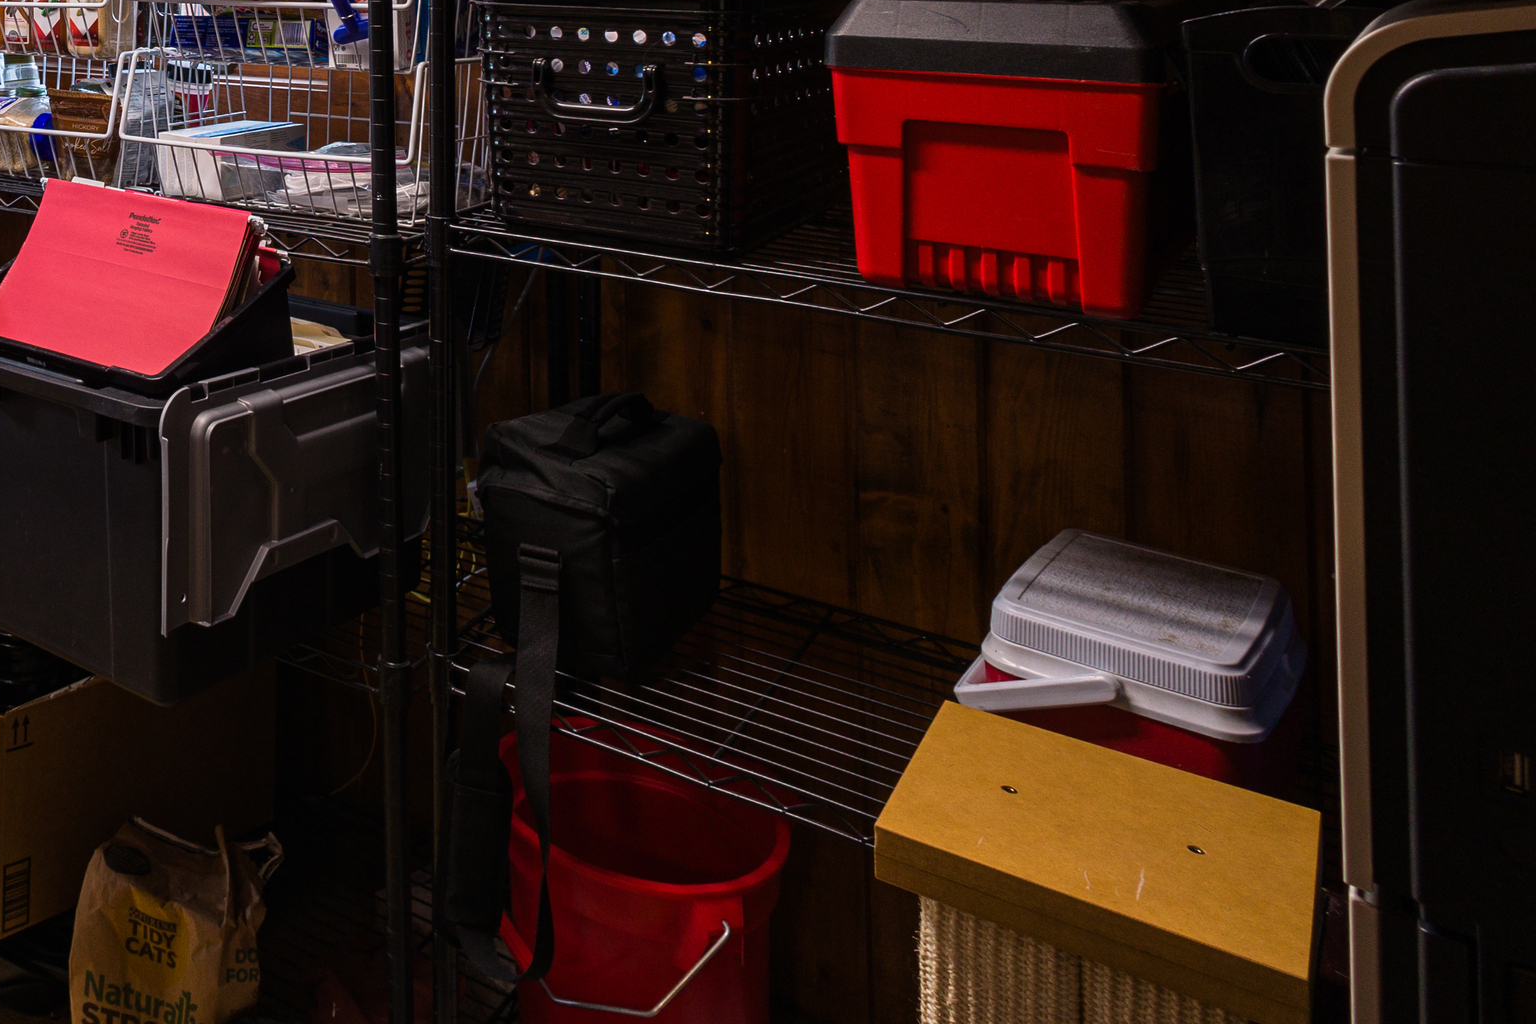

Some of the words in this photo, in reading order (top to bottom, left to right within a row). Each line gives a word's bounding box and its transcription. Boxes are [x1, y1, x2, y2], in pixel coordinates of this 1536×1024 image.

[71, 123, 100, 131] HICKORY
[128, 919, 177, 950] TIDY
[124, 937, 177, 970] CATS
